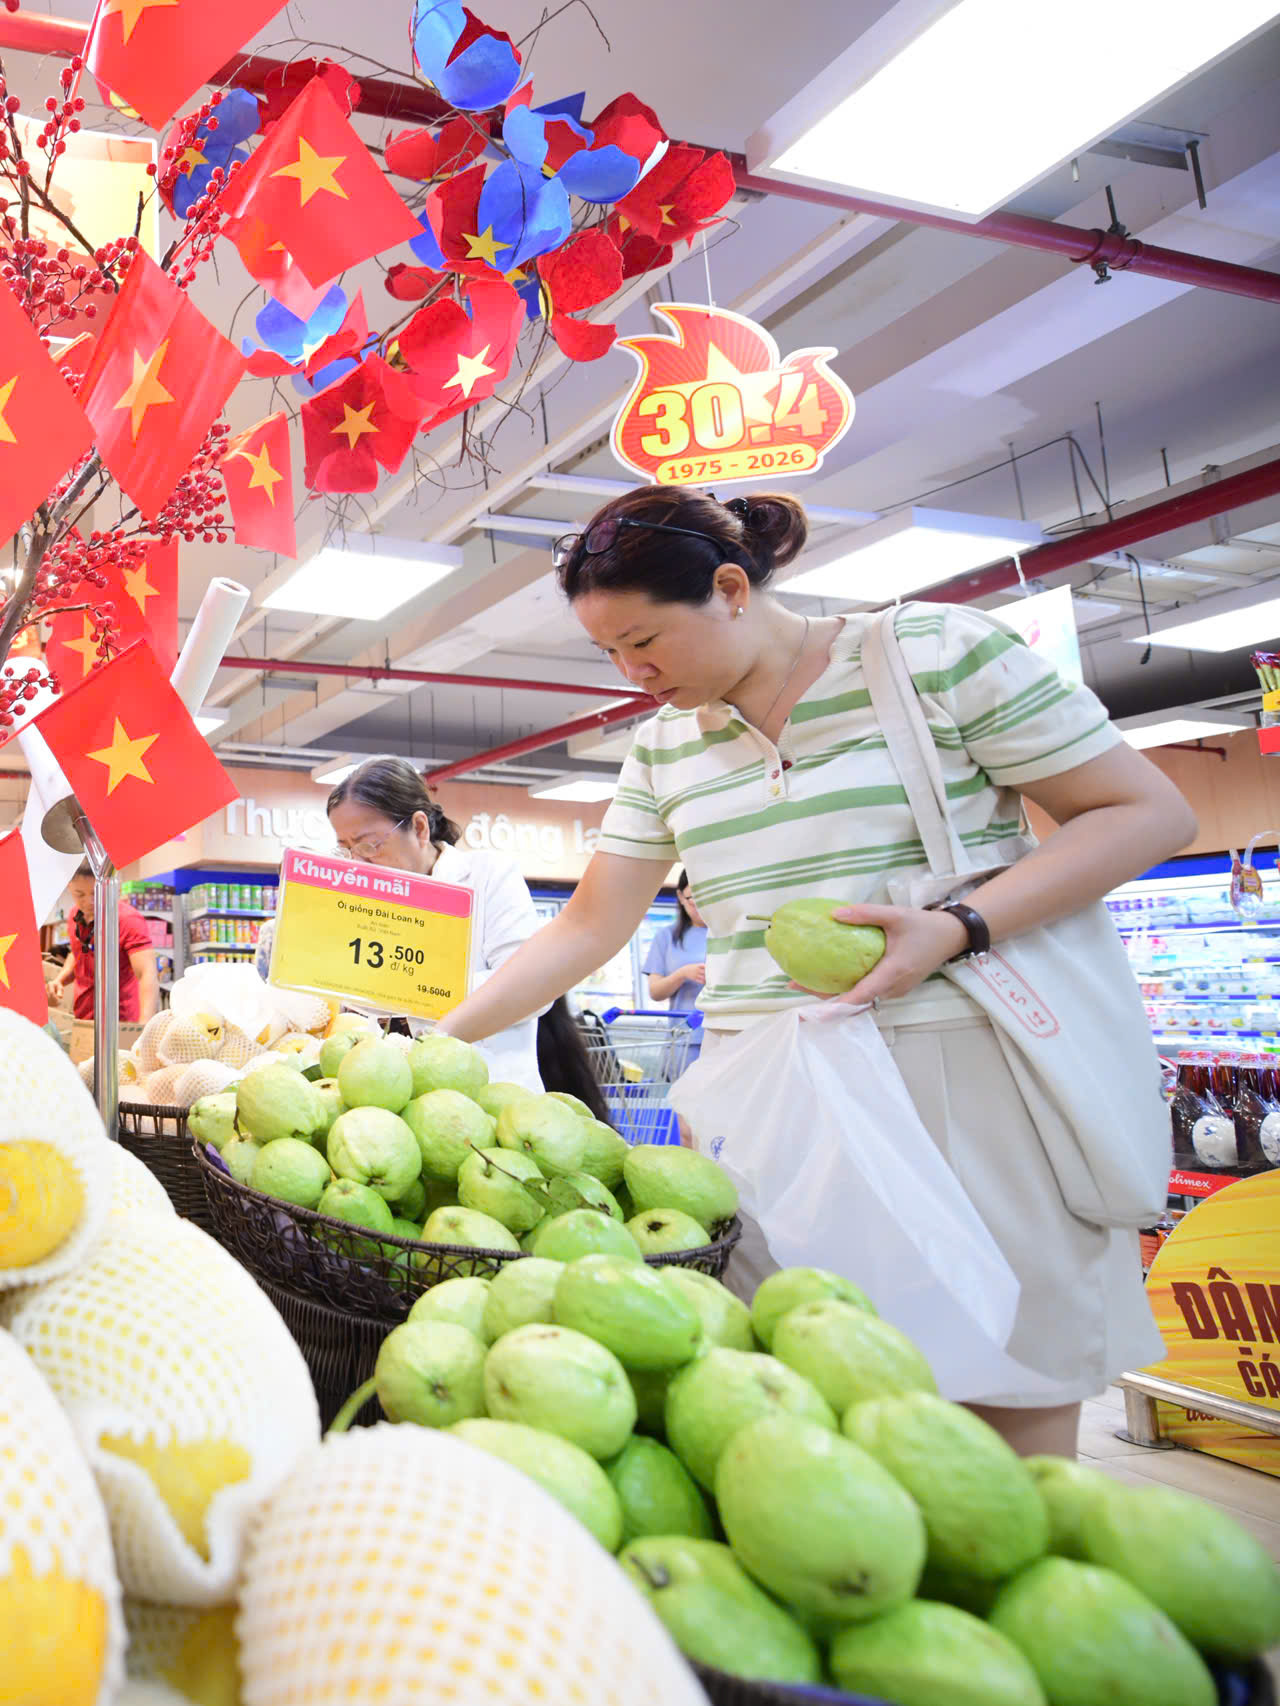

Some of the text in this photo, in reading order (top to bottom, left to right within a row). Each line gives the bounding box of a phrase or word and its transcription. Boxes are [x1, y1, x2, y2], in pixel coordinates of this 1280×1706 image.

[638, 372, 829, 458] 30.4
[667, 459, 722, 480] 1975
[748, 449, 805, 470] 2026
[293, 857, 410, 897] Khuyến mãi
[391, 912, 413, 924] Loan
[414, 917, 425, 927] kg
[348, 937, 425, 969] 13 .500
